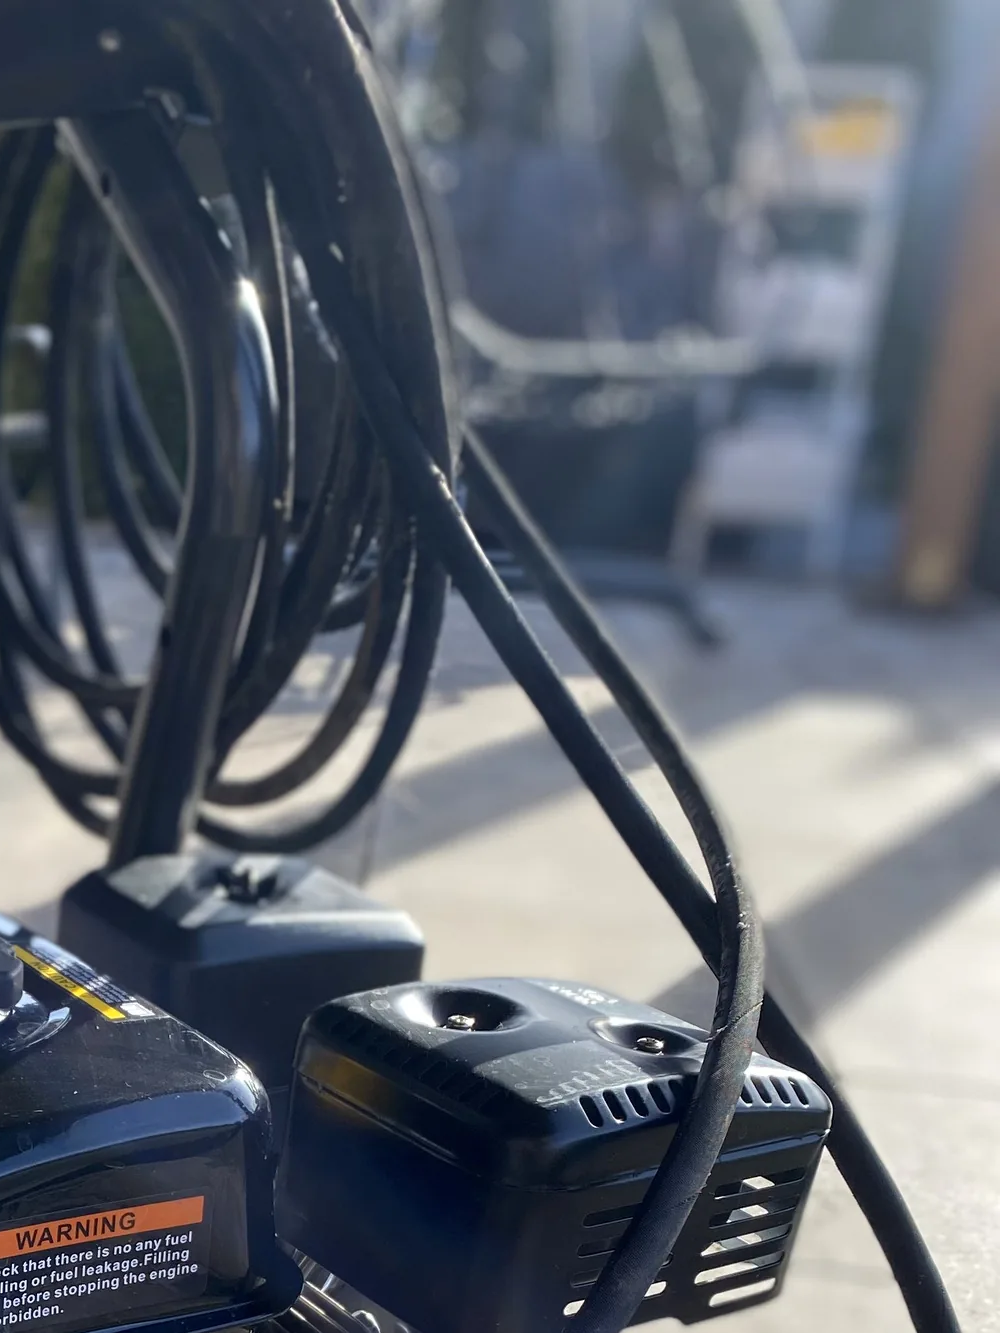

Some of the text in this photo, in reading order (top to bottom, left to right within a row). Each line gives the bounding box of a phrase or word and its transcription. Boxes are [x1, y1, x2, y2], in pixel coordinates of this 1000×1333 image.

[30, 961, 77, 989] CAUTION
[15, 1212, 136, 1250] WARNING
[22, 1257, 51, 1274] that
[55, 1249, 93, 1266] there
[97, 1246, 110, 1258] is
[113, 1242, 132, 1255] no
[135, 1238, 161, 1256] any
[165, 1231, 193, 1247] fuel
[3, 1289, 50, 1310] before
[54, 1276, 119, 1299] stopping
[123, 1269, 146, 1286] the
[149, 1263, 198, 1285] engine
[32, 1273, 47, 1287] or
[50, 1265, 78, 1283] fuel
